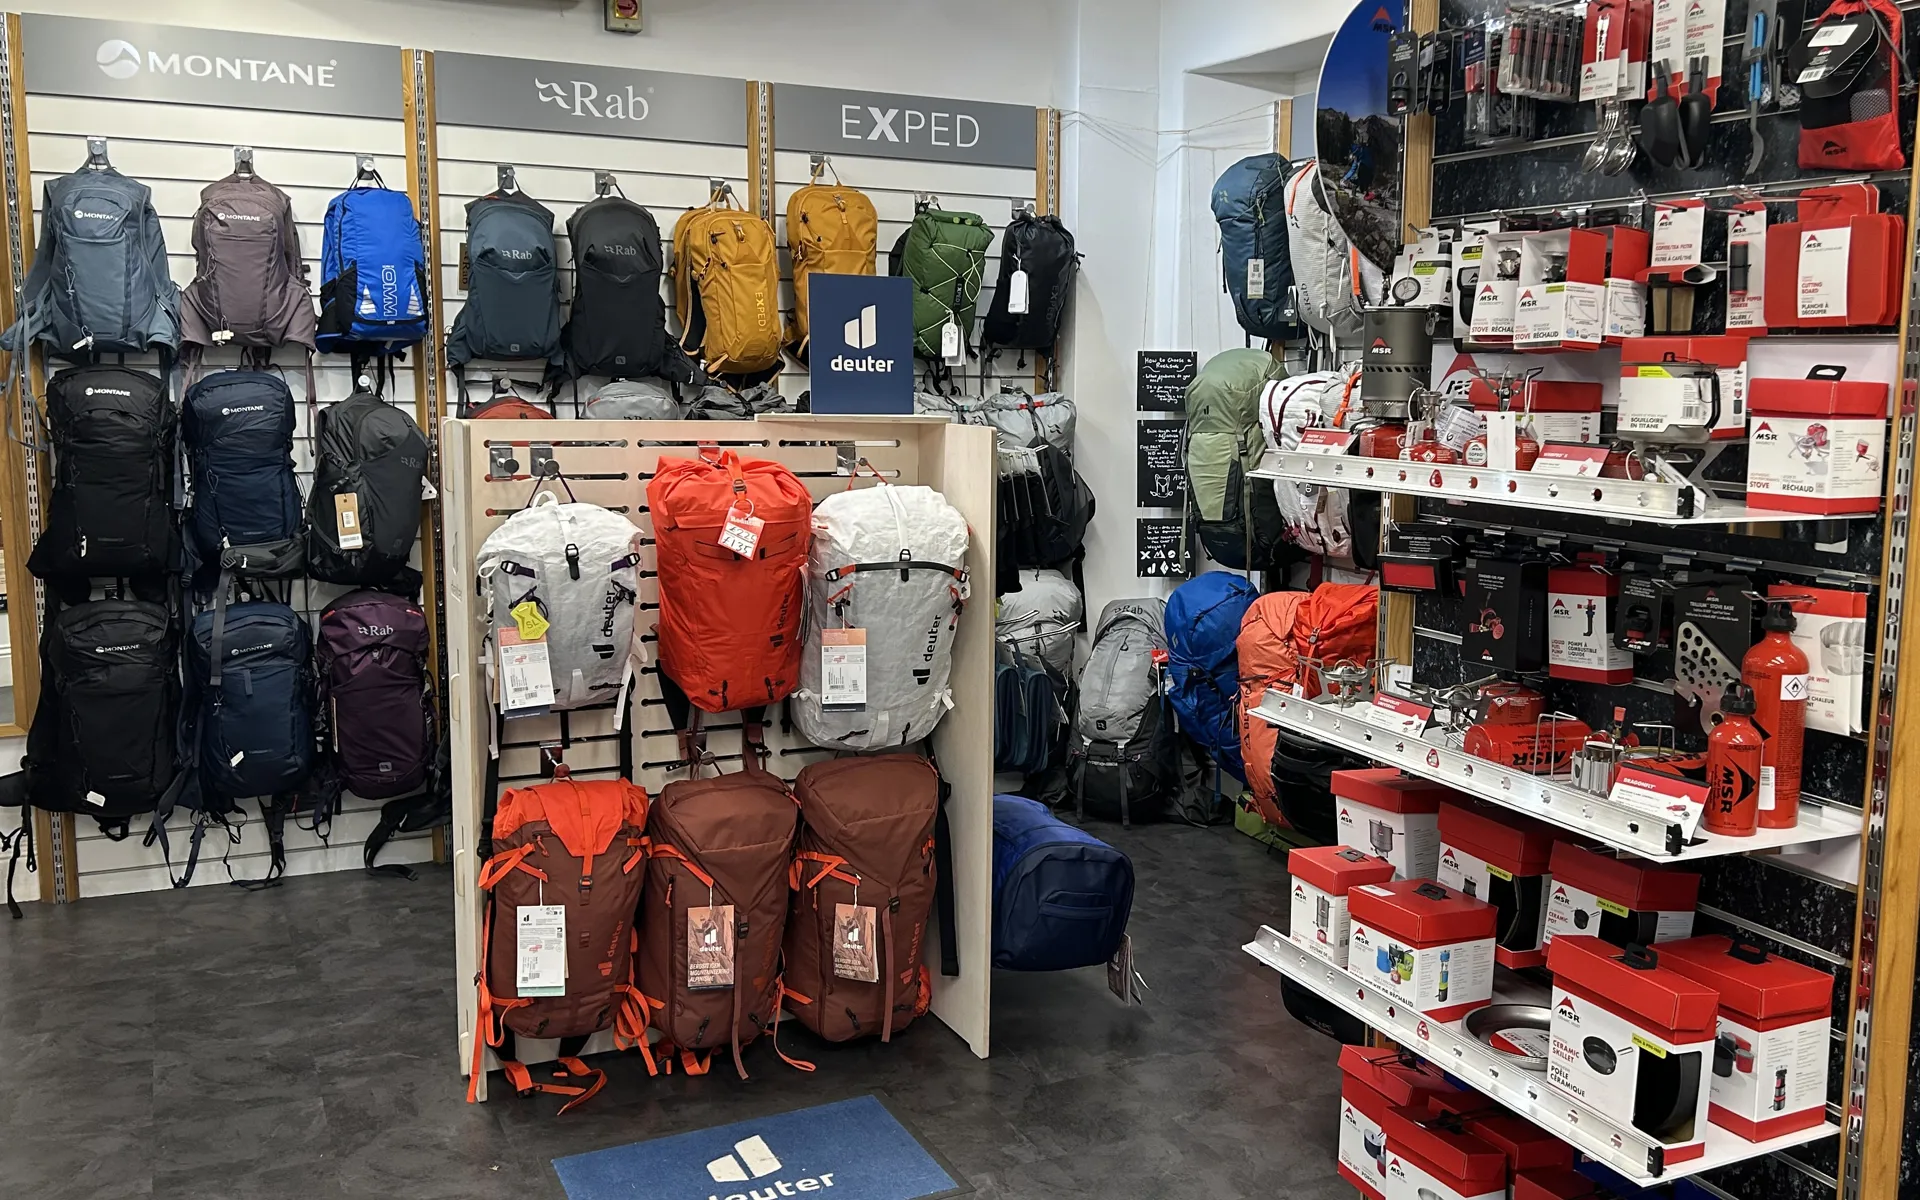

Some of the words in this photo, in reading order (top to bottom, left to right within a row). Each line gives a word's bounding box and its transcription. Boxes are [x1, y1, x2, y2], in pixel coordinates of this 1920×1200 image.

[149, 51, 335, 88] MONTANE
[571, 80, 650, 121] Rab
[841, 104, 980, 149] EXPED
[512, 249, 533, 260] Rab
[615, 245, 637, 257] Rab
[381, 267, 398, 317] OMM
[755, 292, 767, 327] EXPED
[1520, 300, 1538, 308] MSR
[1533, 330, 1559, 339] RÉCHAUD
[1371, 346, 1393, 354] MSR
[830, 354, 895, 373] deuter
[94, 388, 131, 397] MONTANE
[230, 405, 264, 413] MONTANE
[1756, 433, 1778, 441] MSR
[1749, 481, 1770, 489] STOVE
[1782, 483, 1814, 493] RÉCHAUD
[722, 537, 752, 554] £135
[601, 590, 615, 637] deuter
[777, 593, 790, 629] deuter
[1123, 604, 1143, 614] Rab
[1554, 608, 1569, 616] MSR
[526, 618, 541, 629] SL
[369, 625, 394, 636] Rab
[923, 615, 942, 662] deuter
[105, 643, 140, 652] MONTANE
[1811, 696, 1835, 704] CHALEUR
[1512, 750, 1566, 766] MSR
[1623, 777, 1656, 790] DRAGONFLY
[1720, 765, 1735, 814] MSR
[1341, 816, 1353, 825] MSR
[1443, 857, 1459, 870] MSR
[1295, 892, 1307, 901] MSR
[1554, 894, 1570, 905] MSR
[1549, 911, 1568, 924] CERAMIC
[607, 920, 624, 957] deuter
[909, 922, 920, 964] deuter
[1355, 935, 1370, 946] MSR
[843, 942, 864, 950] deuter
[1558, 1007, 1581, 1024] MSR
[1552, 1047, 1574, 1063] SKILLET
[1553, 1040, 1580, 1058] CERAMIC
[1551, 1064, 1569, 1080] POÊLE
[1550, 1073, 1585, 1097] CÉRAMIQUE
[1345, 1114, 1357, 1126] MSR
[1390, 1166, 1405, 1178] MSR
